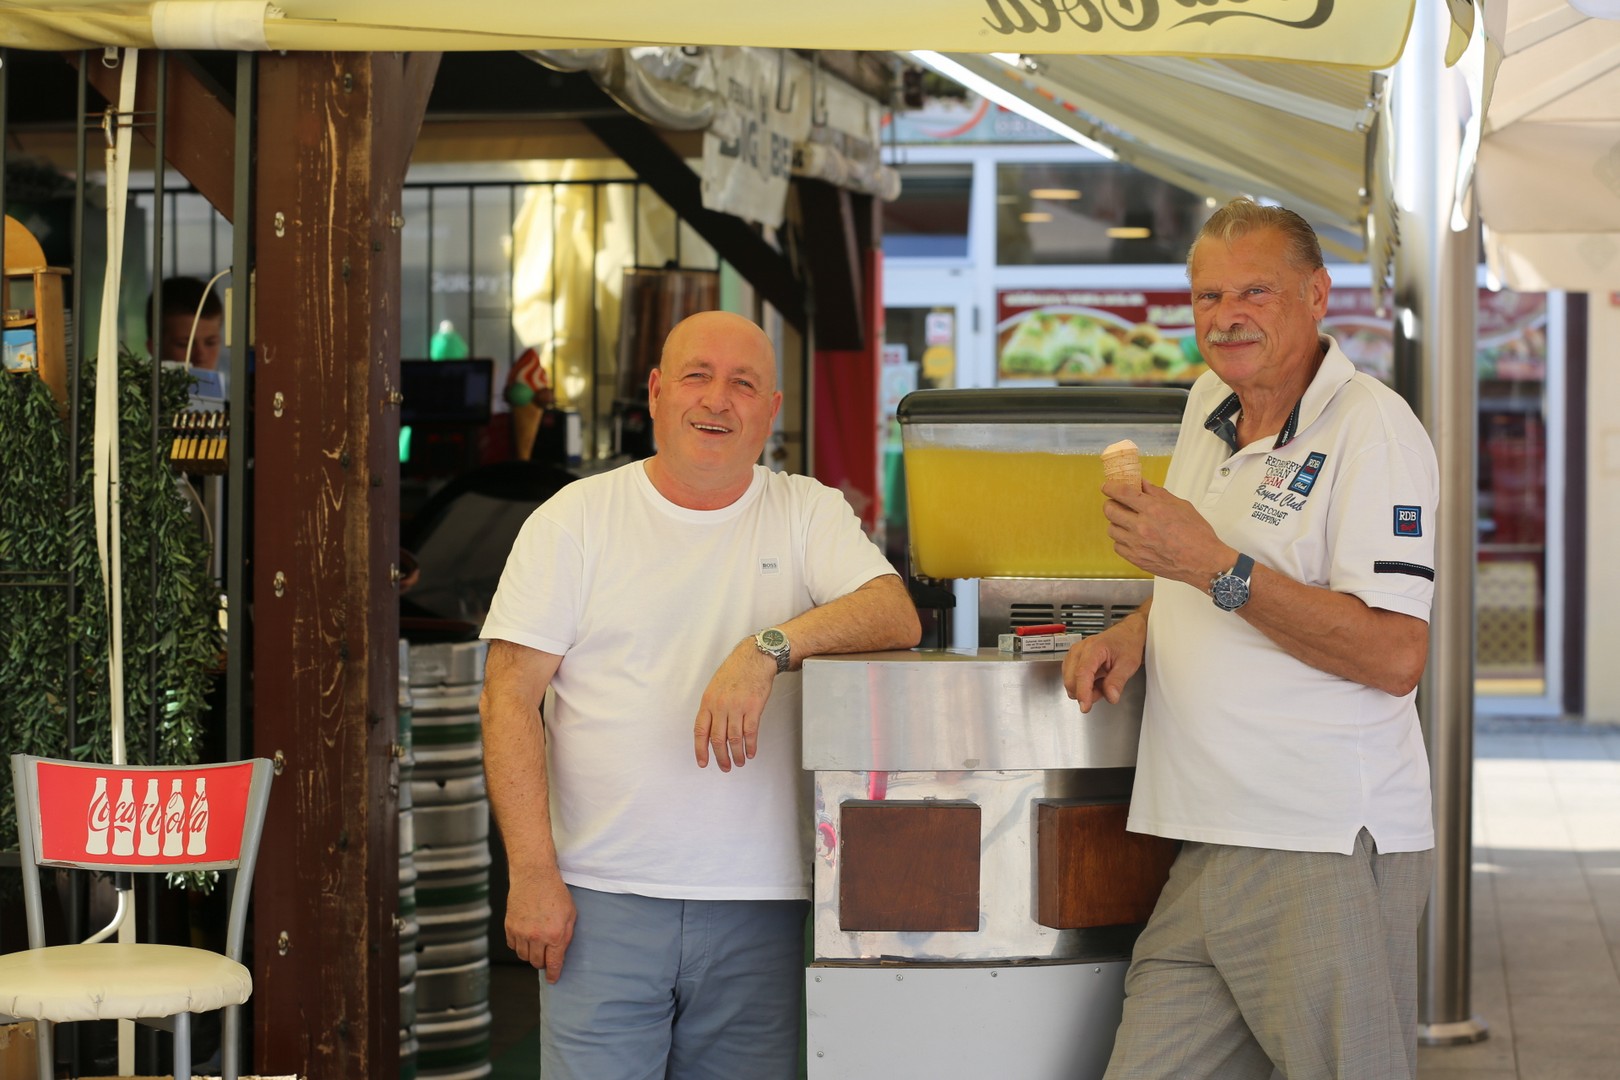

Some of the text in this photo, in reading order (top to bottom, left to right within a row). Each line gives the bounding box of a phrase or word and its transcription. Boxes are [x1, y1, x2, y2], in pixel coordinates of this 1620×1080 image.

[1260, 475, 1284, 489] TEAM
[1255, 485, 1307, 511] Royal Club
[1251, 511, 1281, 526] SHIPPING
[1399, 510, 1416, 521] RDB
[88, 790, 208, 836] Coca-Cola
